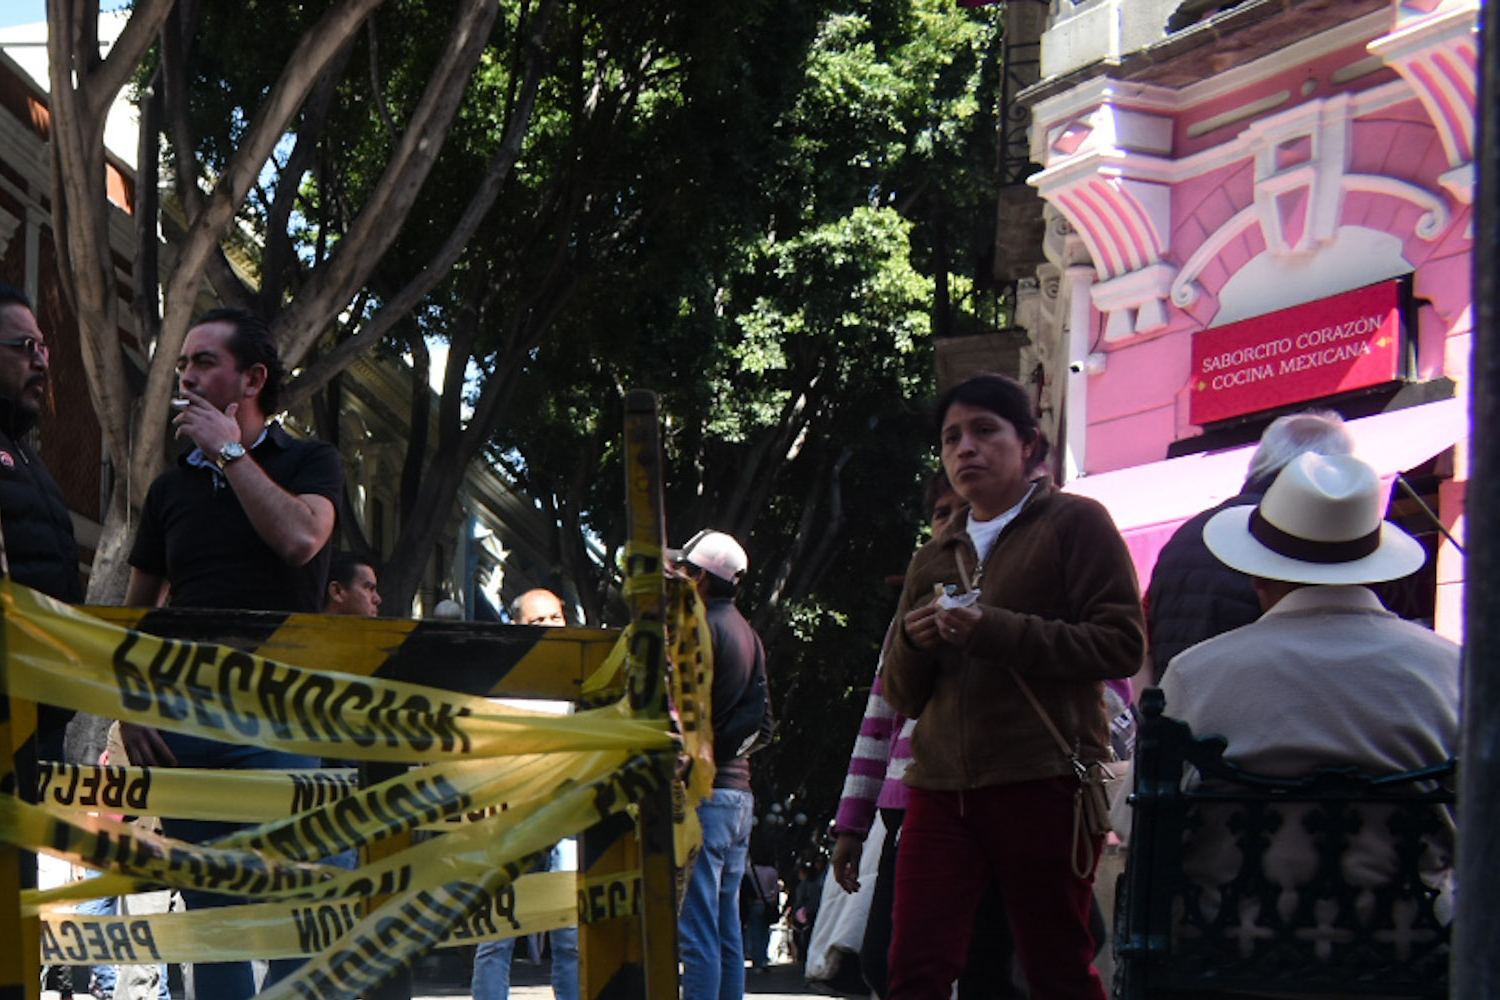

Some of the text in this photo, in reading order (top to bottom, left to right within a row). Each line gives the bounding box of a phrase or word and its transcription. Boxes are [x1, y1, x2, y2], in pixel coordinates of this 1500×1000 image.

[1202, 314, 1383, 373] SABORCITO CORAZÓN
[1212, 341, 1372, 390] COCINA MEXICANA
